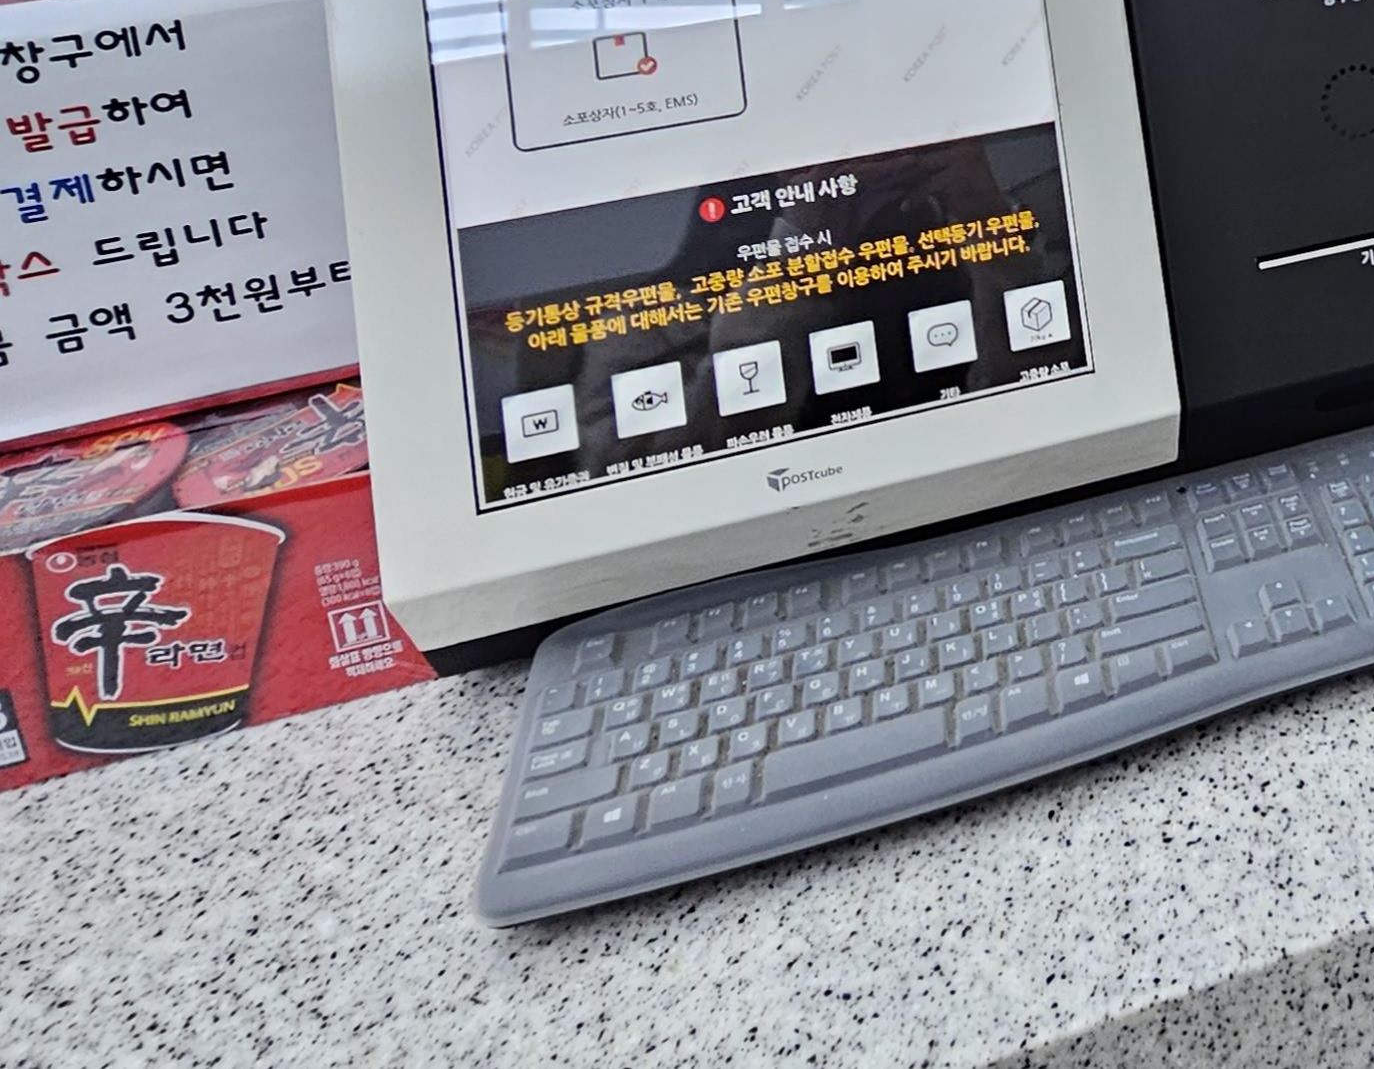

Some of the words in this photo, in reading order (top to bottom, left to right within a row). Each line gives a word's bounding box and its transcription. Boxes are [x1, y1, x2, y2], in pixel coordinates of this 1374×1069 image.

[0, 19, 187, 84] 창구에서
[6, 89, 193, 153] 발급하여
[665, 91, 699, 113] EMS)
[0, 151, 236, 224] 결제하시면
[730, 188, 772, 215] 고객
[775, 181, 816, 208] 안내
[818, 173, 858, 201] 사항
[92, 211, 269, 268] 드립니다
[737, 237, 782, 262] 우편물
[784, 232, 815, 252] 접수
[817, 228, 833, 248] 시
[504, 301, 581, 333] 등기통상
[583, 281, 682, 319] 규격우편물,
[689, 265, 745, 295] 고중량
[747, 259, 785, 284] 소포
[786, 247, 856, 279] 분할접수
[857, 234, 914, 262] 우편물,
[917, 219, 984, 250] 선택등기
[986, 209, 1040, 236] 우편물,
[527, 329, 568, 352] 아래
[570, 315, 627, 346] 물품에
[629, 300, 704, 332] 대해서는
[707, 290, 743, 316] 기존
[745, 270, 834, 306] 우편창구를
[836, 259, 906, 290] 이용하여
[905, 247, 958, 276] 주시기
[959, 233, 1032, 264] 바랍니다.
[45, 302, 137, 355] 금액
[52, 564, 192, 701] 辛
[146, 638, 228, 670] 라면
[128, 713, 165, 727] SHIN
[168, 699, 236, 723] RAMYUN
